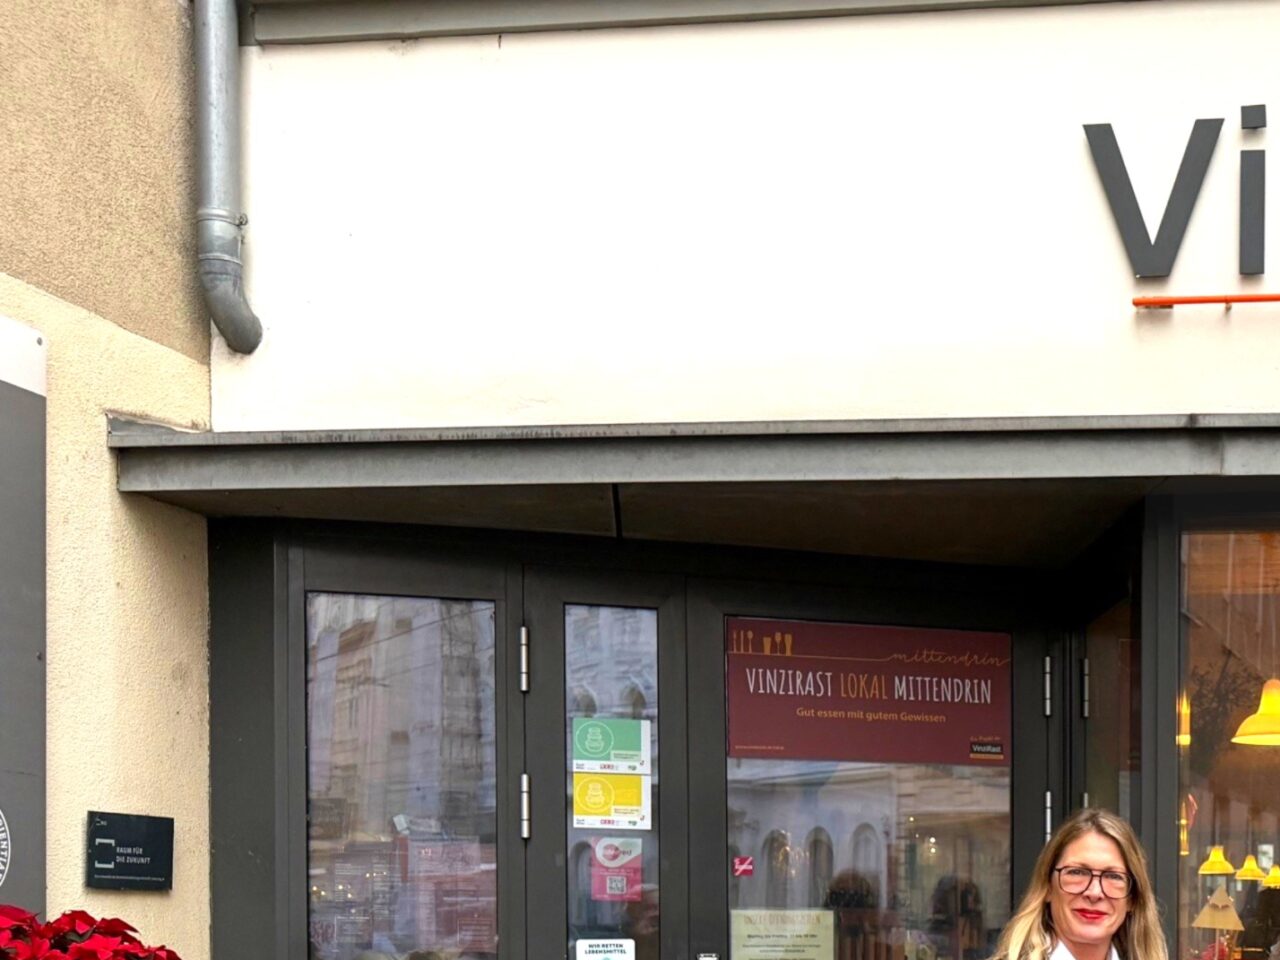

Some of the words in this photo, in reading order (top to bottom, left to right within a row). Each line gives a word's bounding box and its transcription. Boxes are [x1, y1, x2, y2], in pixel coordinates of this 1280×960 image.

[745, 667, 833, 698] VINZIRAST
[839, 672, 888, 700] LOKAL
[894, 675, 992, 704] MITTENDRIN
[796, 707, 815, 718] Gut
[817, 710, 846, 719] essen
[847, 709, 865, 720] mit
[865, 711, 898, 722] gutem
[900, 712, 946, 723] Gewissen
